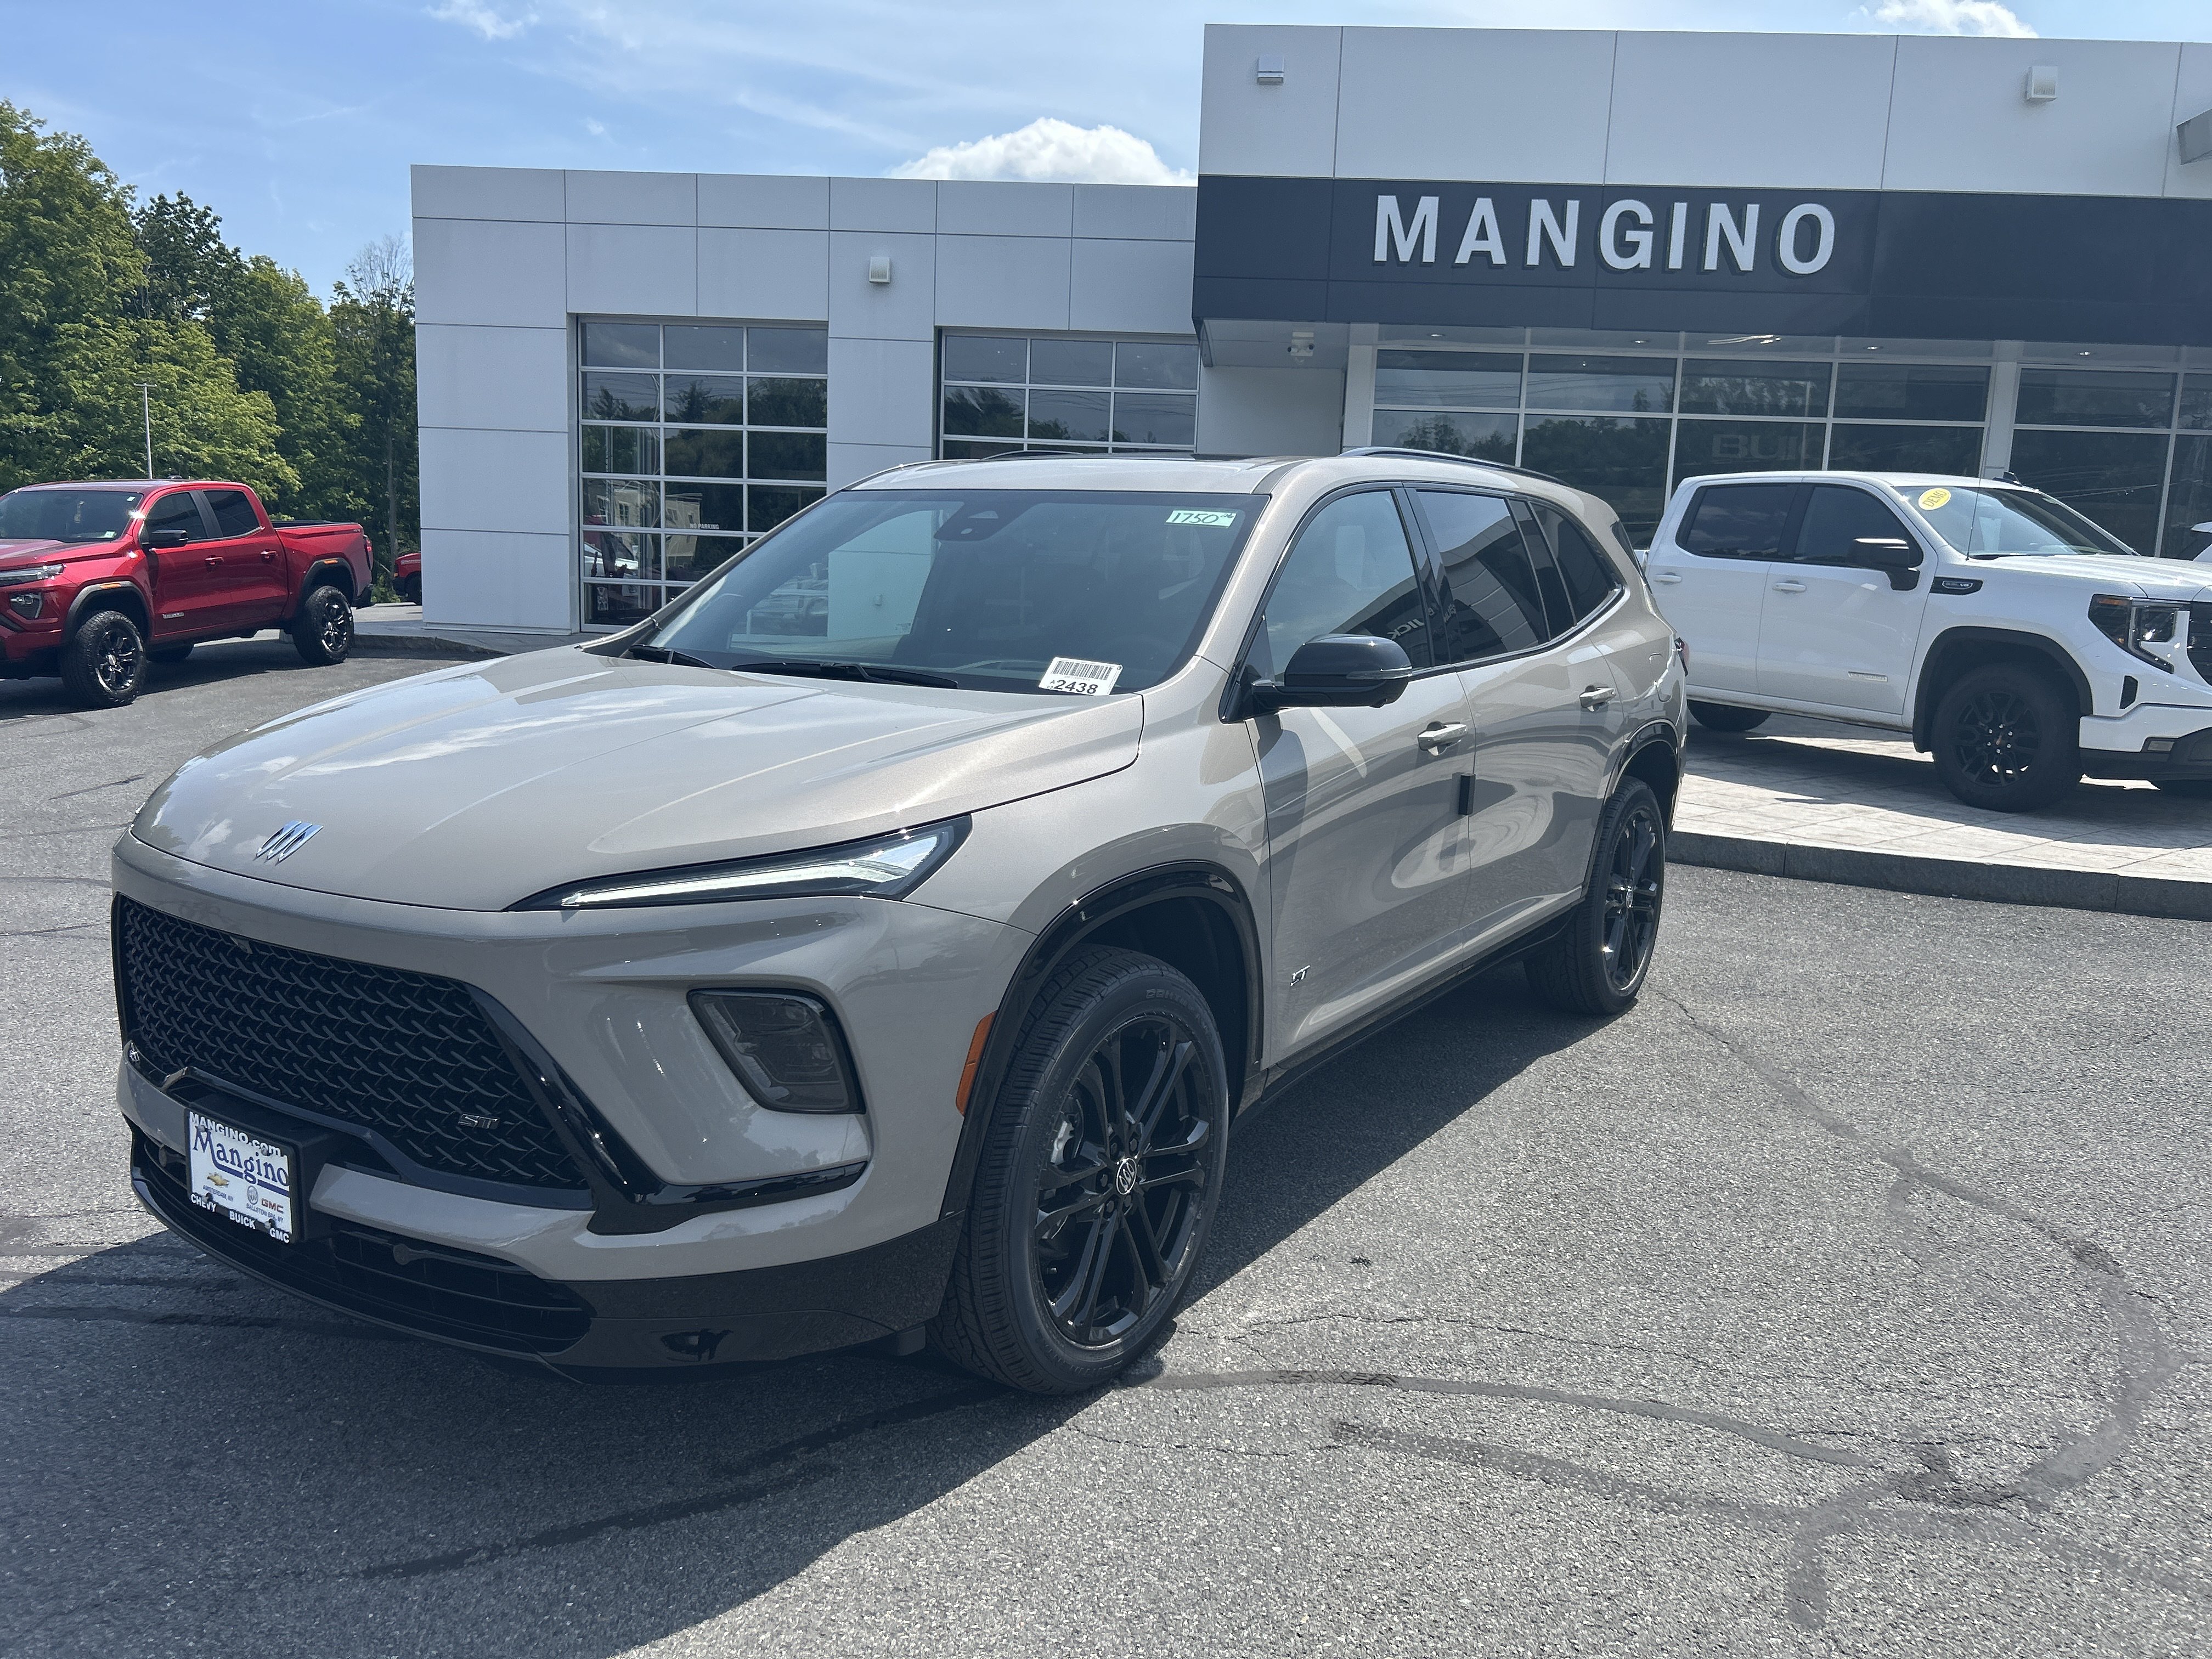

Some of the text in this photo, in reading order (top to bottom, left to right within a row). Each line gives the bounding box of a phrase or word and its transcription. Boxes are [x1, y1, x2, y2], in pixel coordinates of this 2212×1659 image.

[1373, 194, 1836, 275] MANGINO
[1922, 490, 1948, 507] DEMO
[1053, 680, 1098, 694] 2438
[458, 1114, 499, 1130] ST
[189, 1111, 282, 1156] MANGINO.com
[193, 1126, 290, 1187] Mangino
[246, 1203, 267, 1216] BALLSTON
[261, 1198, 285, 1214] GMC
[229, 1210, 256, 1229] BUICK
[269, 1228, 290, 1244] GMC
